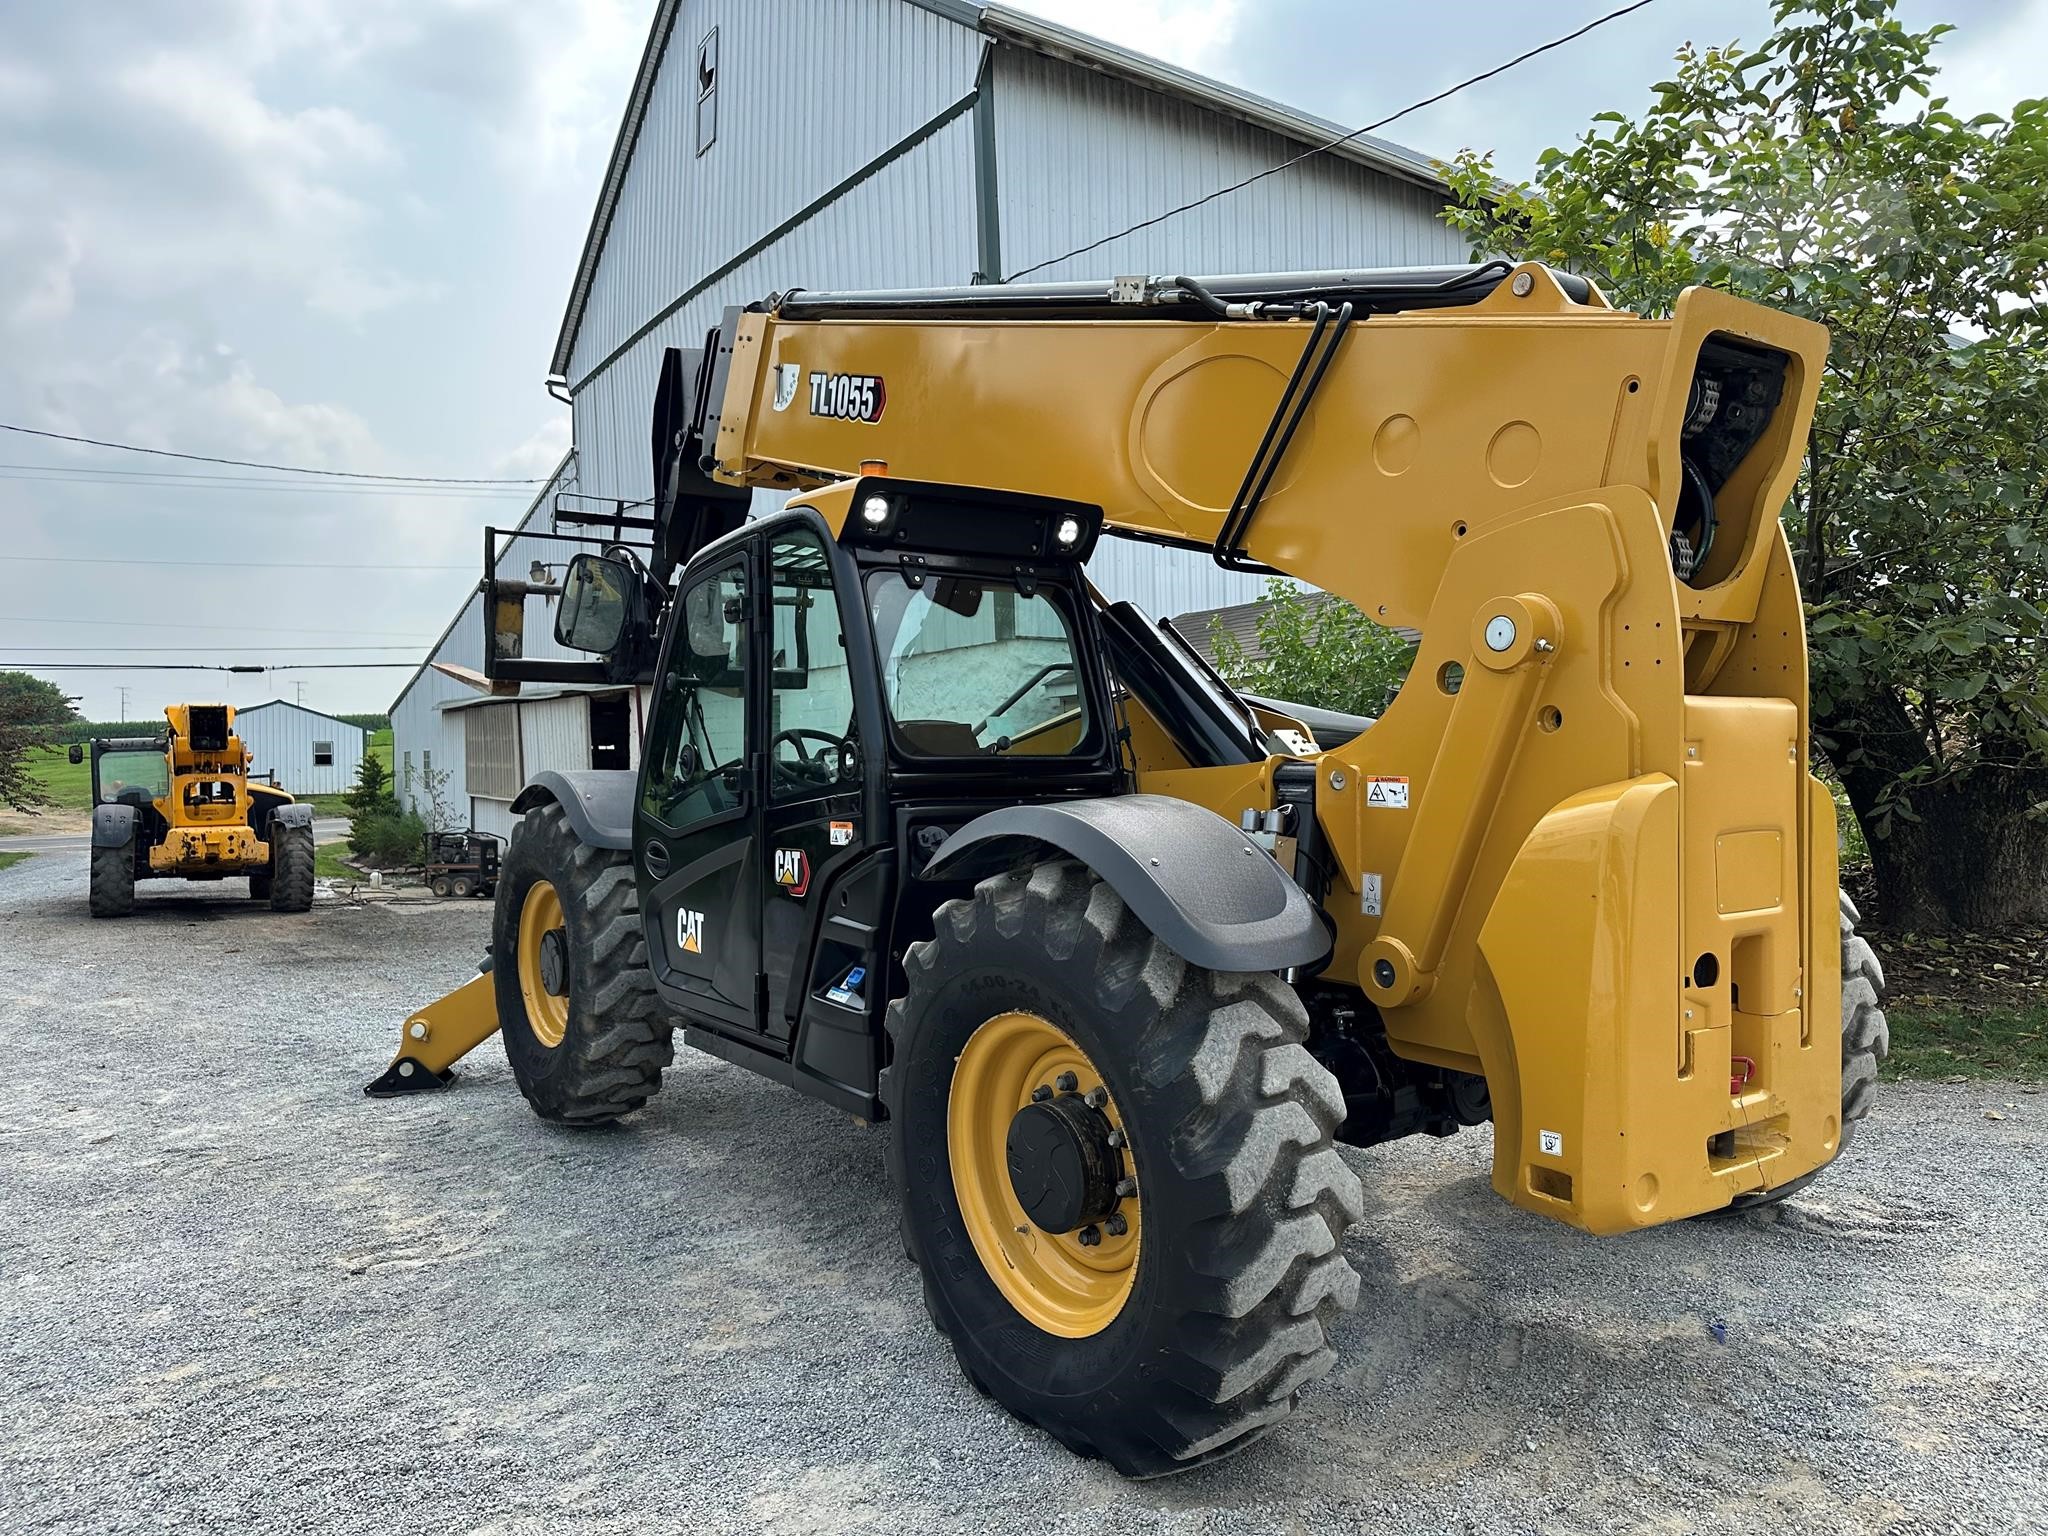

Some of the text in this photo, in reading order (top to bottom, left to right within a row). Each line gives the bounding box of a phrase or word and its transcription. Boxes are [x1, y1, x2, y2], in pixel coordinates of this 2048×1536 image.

[809, 373, 875, 420] TL1055
[775, 849, 801, 885] CAT
[676, 906, 704, 954] CAT
